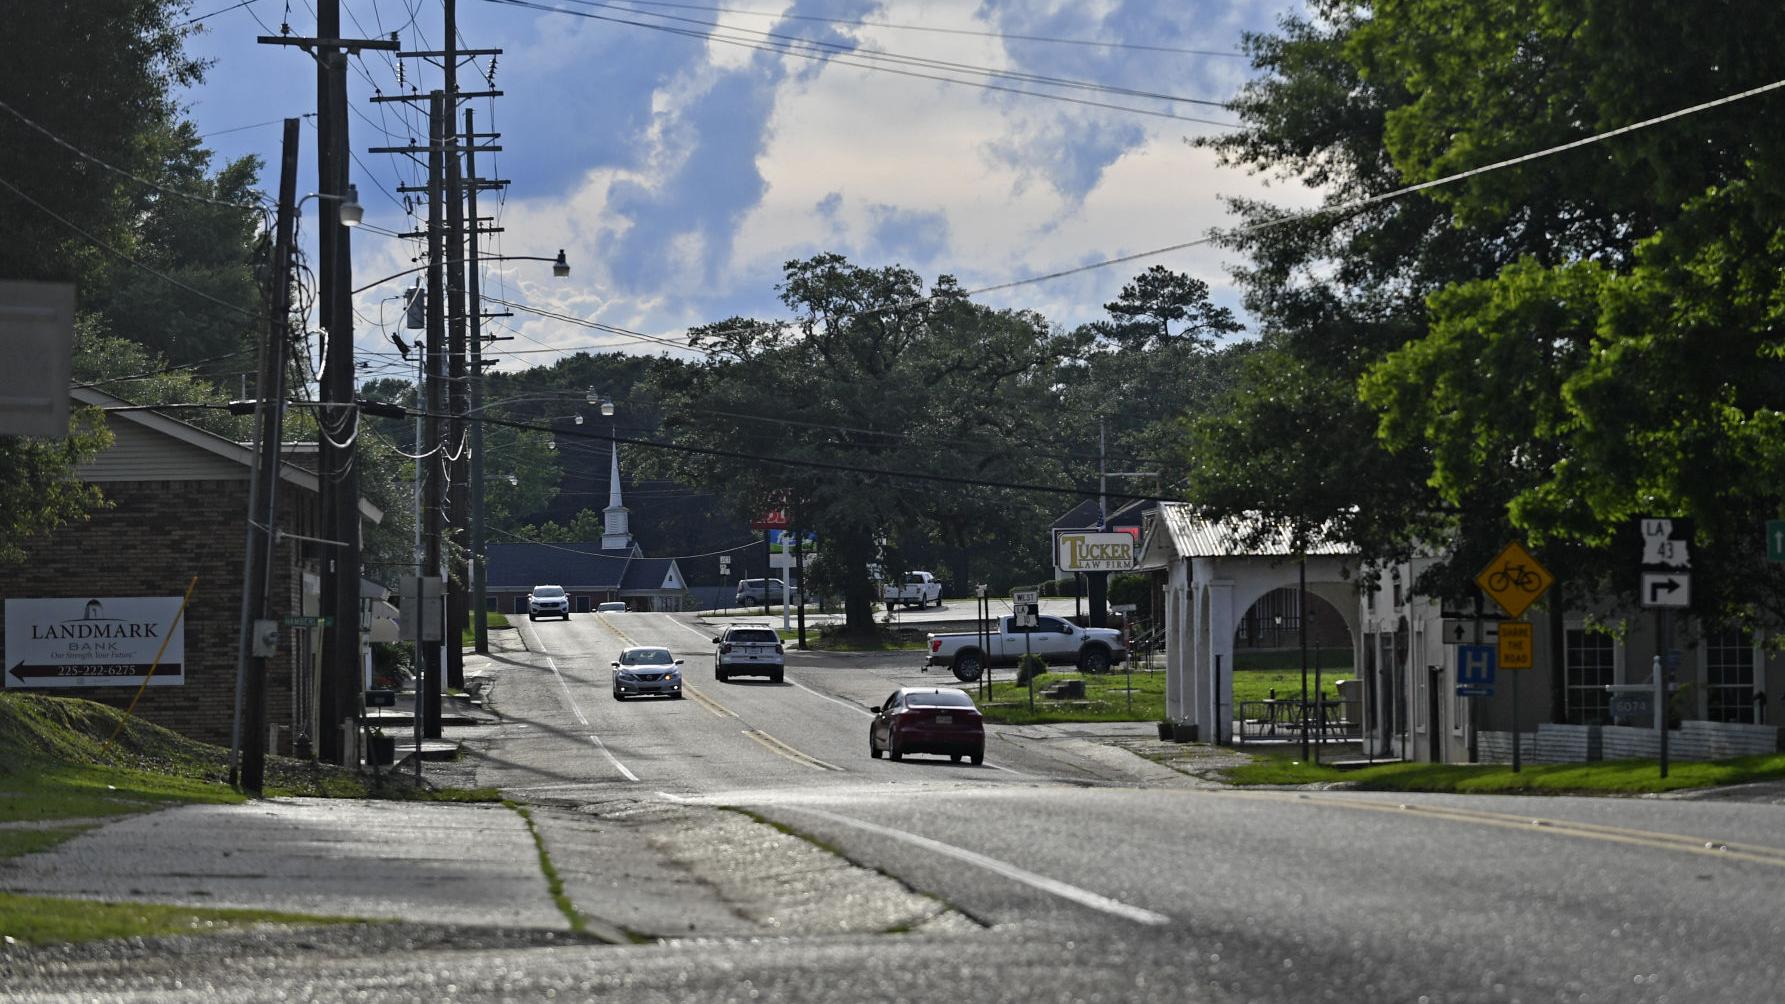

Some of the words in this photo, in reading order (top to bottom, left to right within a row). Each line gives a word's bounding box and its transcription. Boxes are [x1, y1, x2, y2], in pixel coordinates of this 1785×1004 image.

[1647, 521, 1664, 537] LA
[1657, 541, 1673, 559] 43
[1079, 561, 1101, 569] LAW
[1106, 561, 1131, 569] FIRM
[1017, 594, 1034, 602] WEST
[32, 623, 158, 640] LANDMARK
[69, 642, 119, 651] BANK
[57, 665, 137, 677] 225-222-6275
[1465, 651, 1488, 679] H
